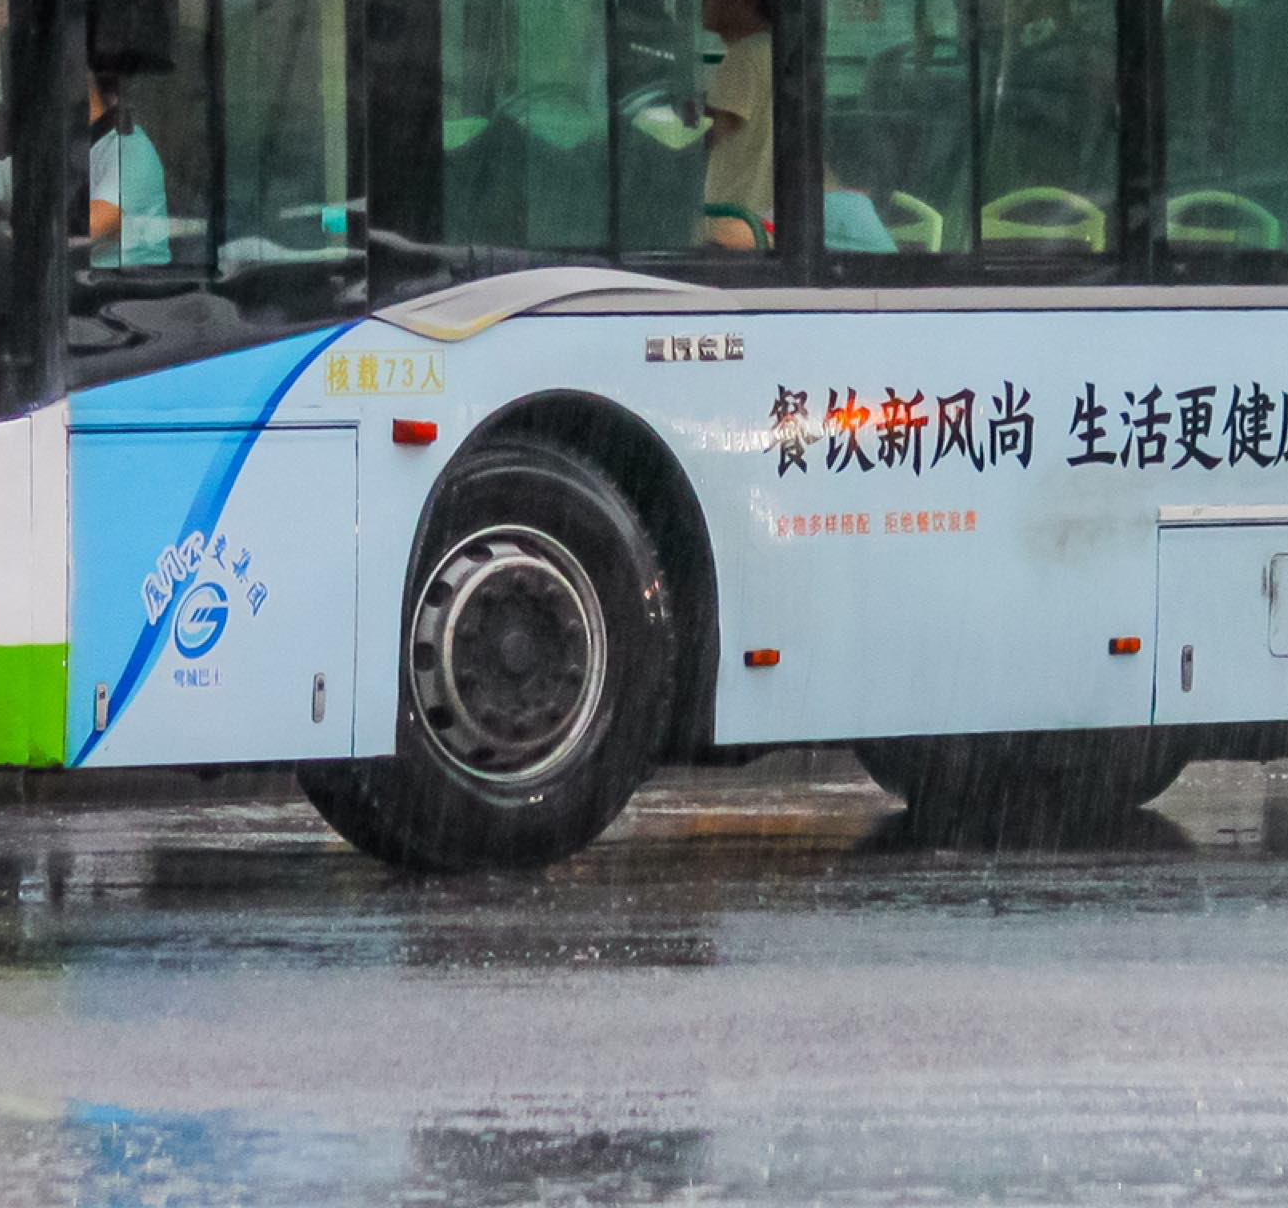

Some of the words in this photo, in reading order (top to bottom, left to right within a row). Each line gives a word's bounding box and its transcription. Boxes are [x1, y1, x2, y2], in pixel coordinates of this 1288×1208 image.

[325, 354, 443, 392] 核载73人
[763, 380, 1036, 478] 餐饮新风尚
